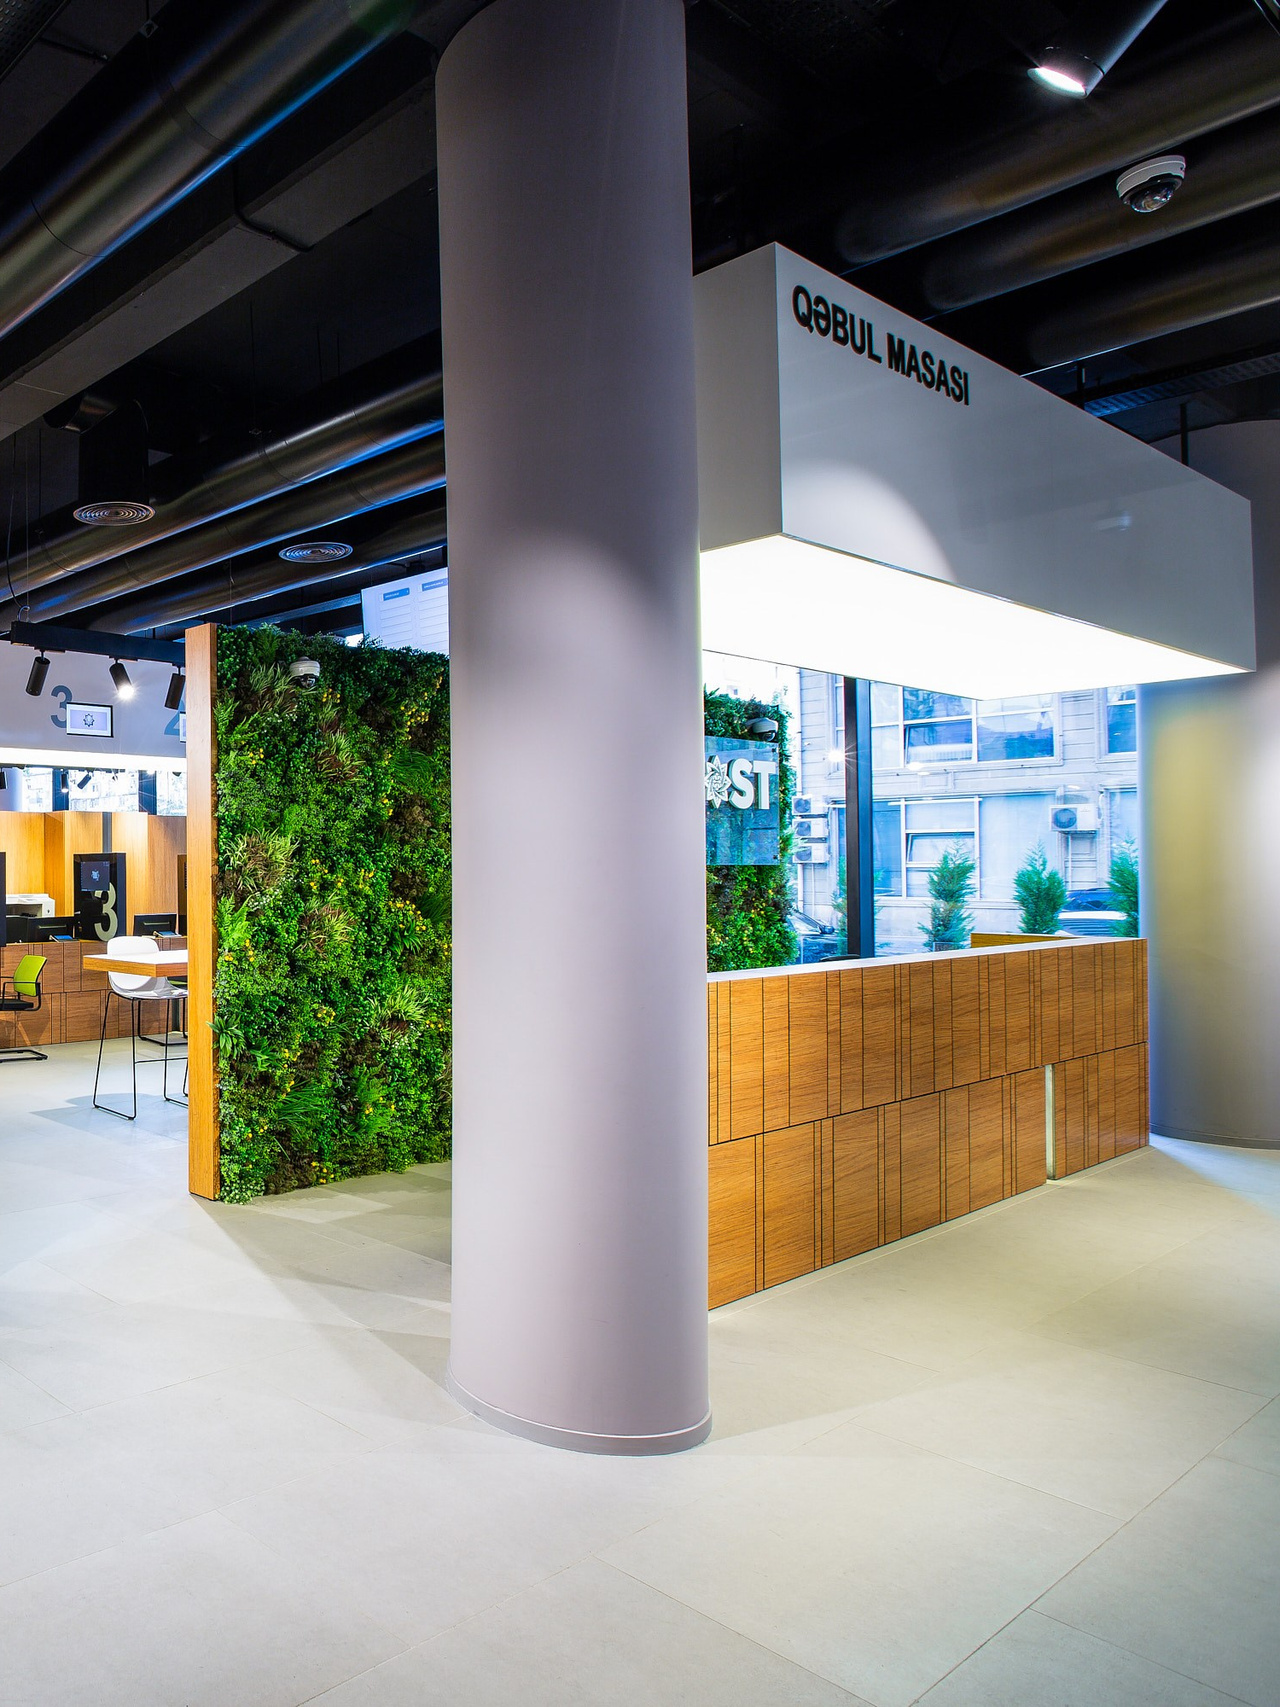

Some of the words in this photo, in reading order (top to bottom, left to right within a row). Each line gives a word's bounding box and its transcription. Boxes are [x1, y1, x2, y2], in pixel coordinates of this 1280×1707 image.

[792, 285, 882, 364] QƏBUL
[886, 332, 970, 406] MASASI
[51, 685, 73, 729] 3
[94, 882, 118, 942] 3
